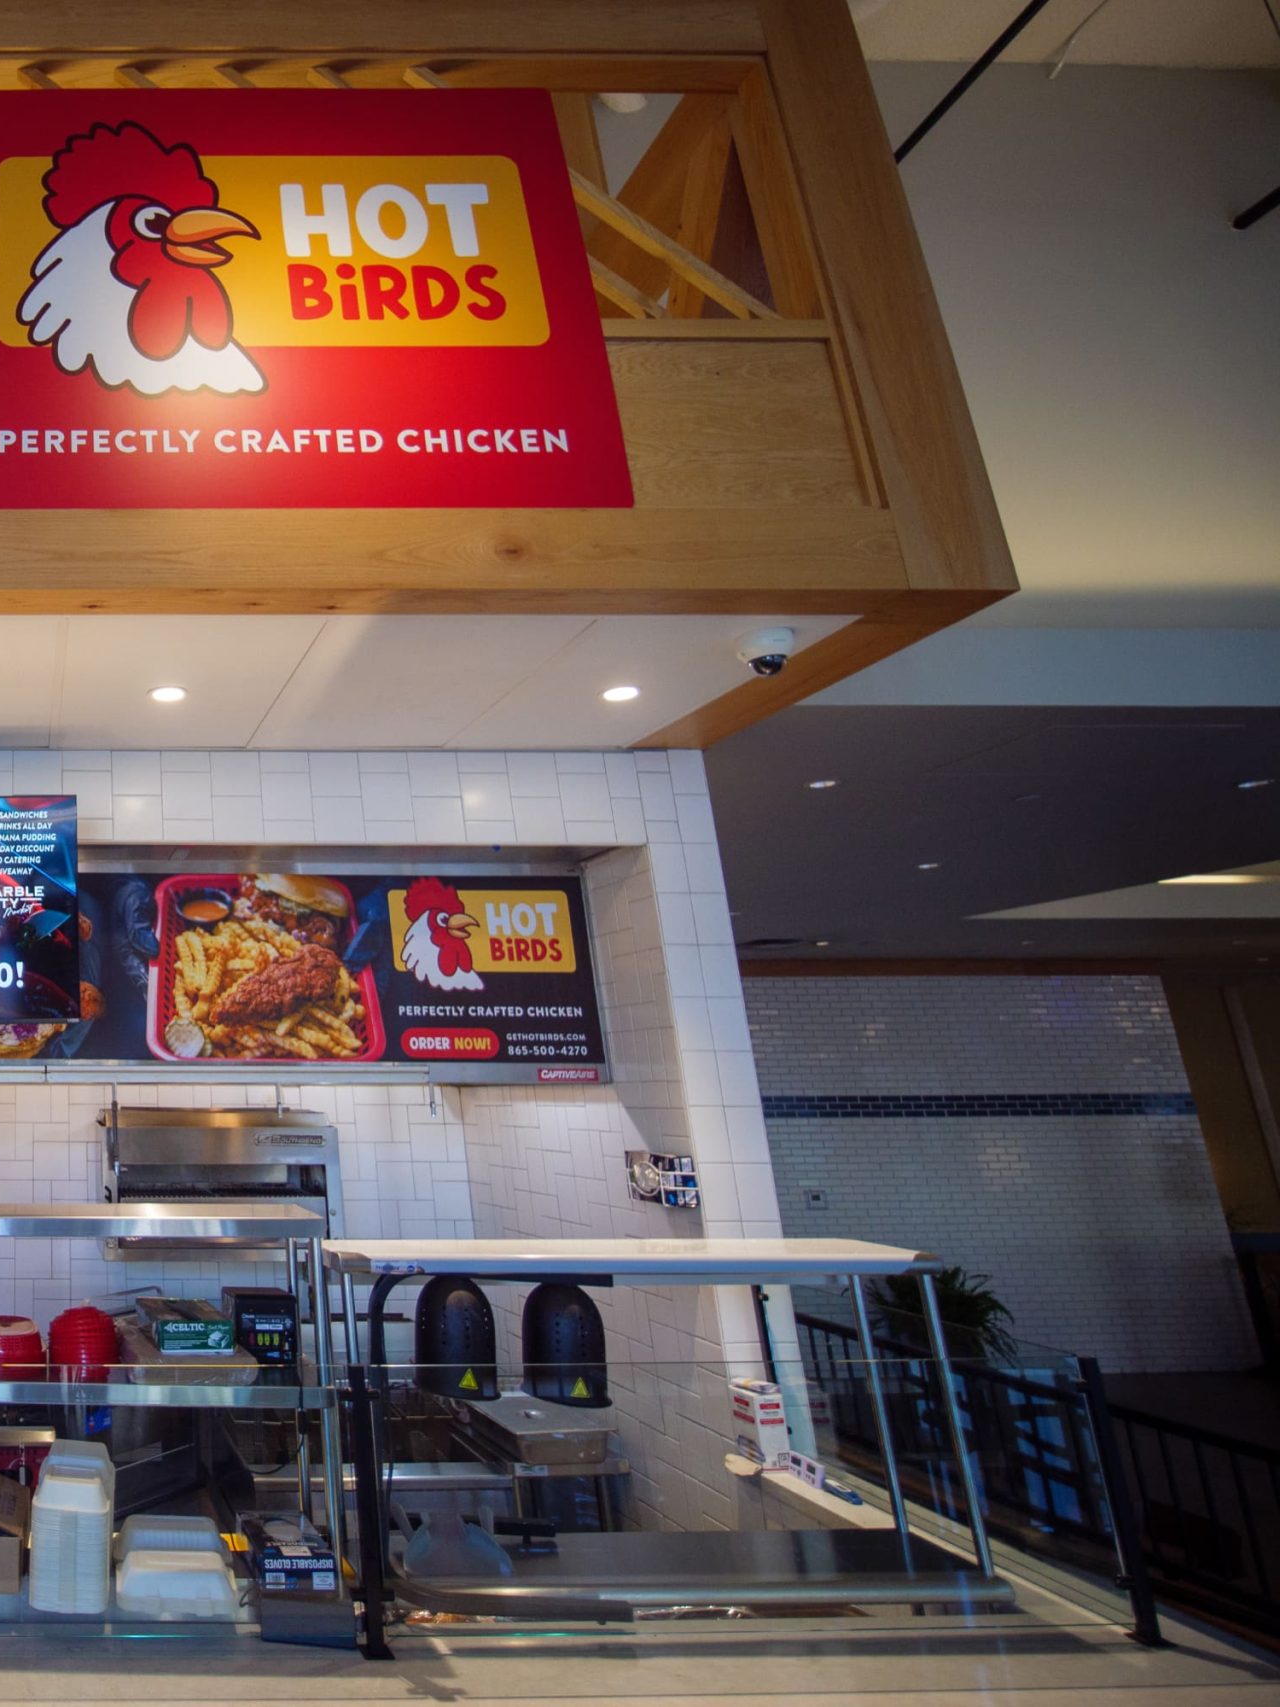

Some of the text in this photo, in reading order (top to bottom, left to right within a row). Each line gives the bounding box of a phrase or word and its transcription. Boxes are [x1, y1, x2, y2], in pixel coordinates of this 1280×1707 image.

[279, 183, 489, 258] HOT
[213, 429, 384, 453] CRAFTED
[397, 429, 569, 453] CHICKEN
[0, 810, 48, 819] SANDWICHES
[22, 822, 35, 830] ALL
[37, 822, 53, 830] DAY
[22, 833, 56, 841] PUDDING
[0, 845, 15, 853] DAY
[16, 844, 55, 852] DISCOUNT
[4, 856, 41, 864] CATERING
[485, 902, 557, 936] HOT
[398, 1005, 583, 1017] PERFECTLY CRAFTED CHICKEN
[506, 1032, 587, 1042] GETHOTBIRDS.COM
[409, 1036, 491, 1050] ORDER NOW!
[508, 1045, 588, 1056] 865-500-4270
[172, 1322, 206, 1331] CELTIC
[264, 1559, 334, 1569] DISPOSABLE GLOVES
